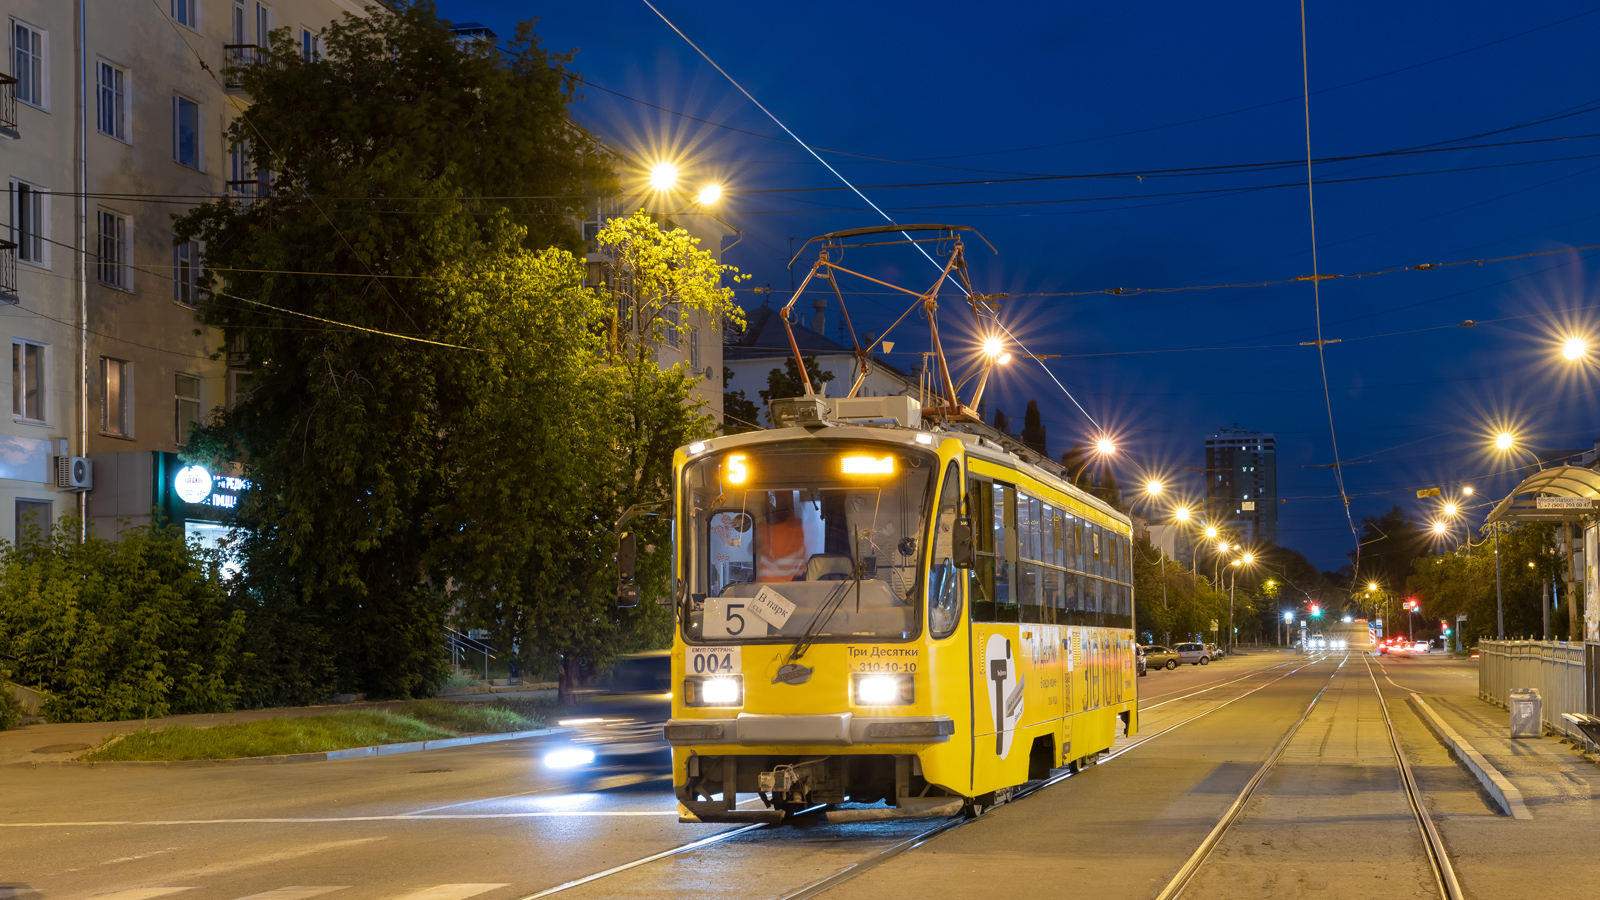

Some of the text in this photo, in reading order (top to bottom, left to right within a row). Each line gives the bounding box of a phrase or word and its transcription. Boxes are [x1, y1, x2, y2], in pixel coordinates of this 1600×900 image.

[728, 455, 746, 483] 5
[758, 592, 789, 618] В парк
[726, 604, 745, 635] 5
[694, 653, 733, 674] 004
[847, 646, 918, 658] Три Десятки
[859, 662, 917, 672] 310-10-10
